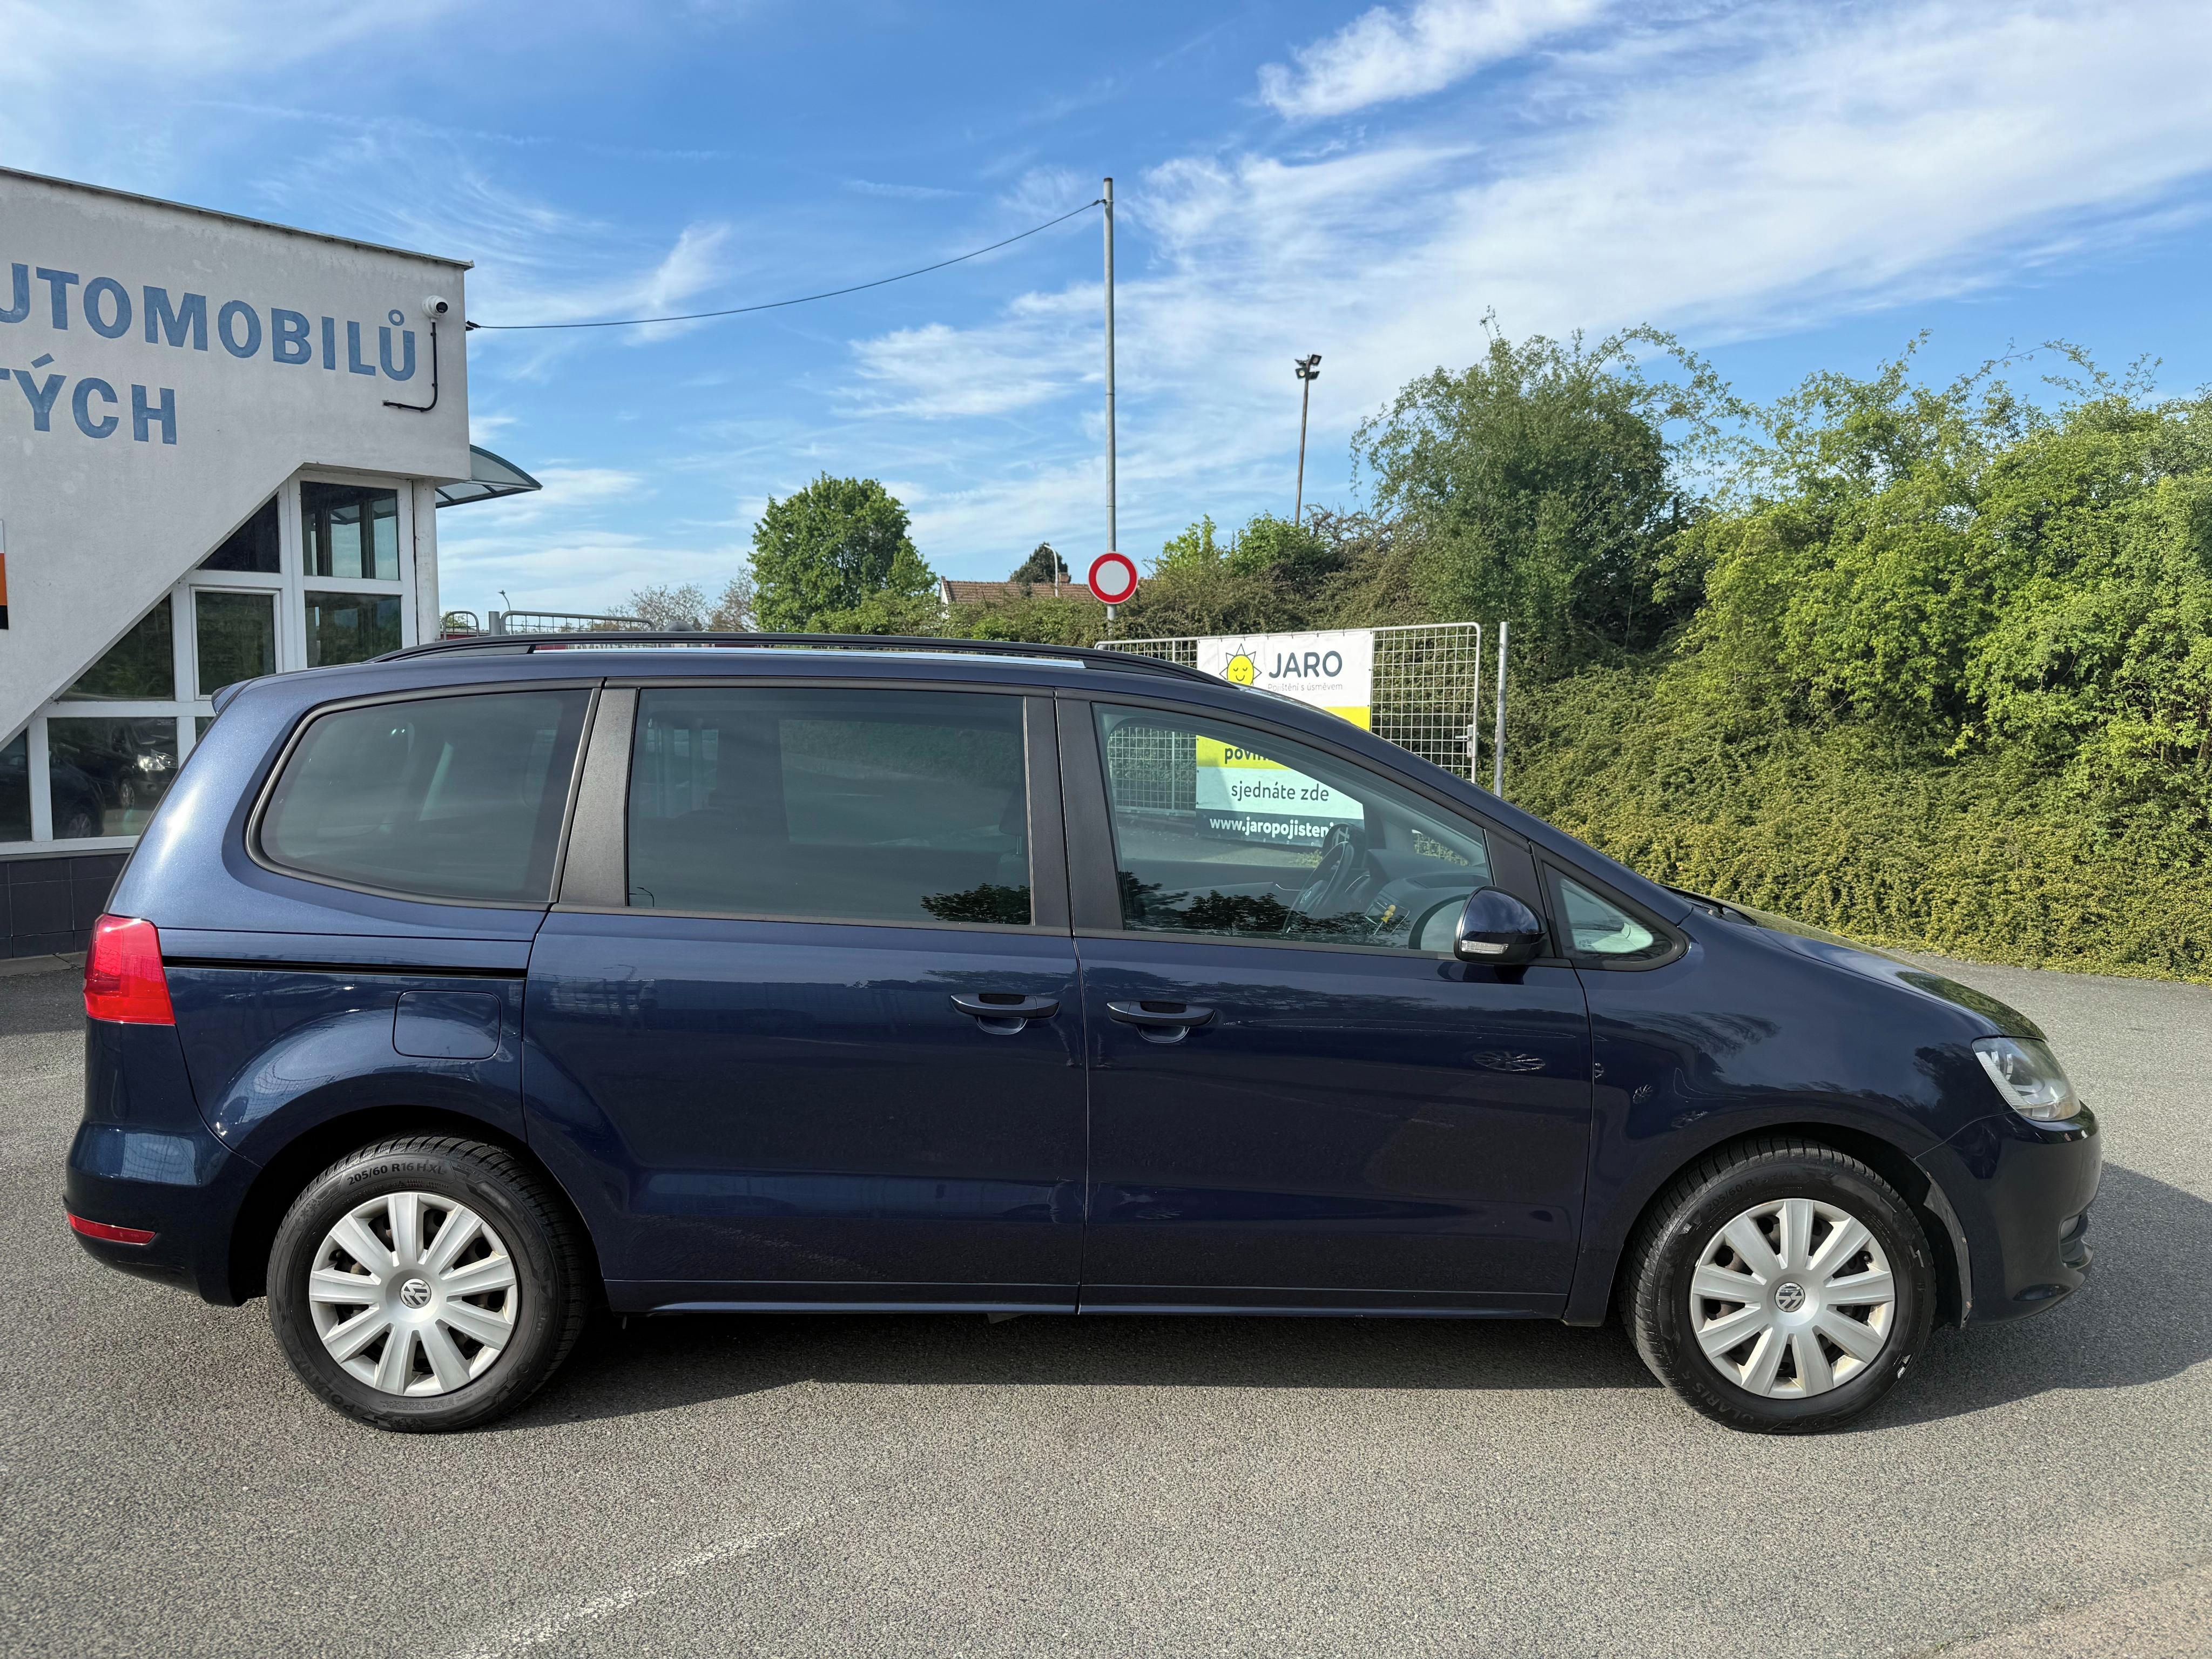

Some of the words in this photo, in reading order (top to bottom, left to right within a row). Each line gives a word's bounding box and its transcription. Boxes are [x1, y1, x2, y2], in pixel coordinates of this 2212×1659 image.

[1269, 650, 1343, 678] JARO
[1268, 683, 1299, 692] Pojištění
[1307, 682, 1343, 691] úsměvem
[1231, 781, 1296, 801] sjednáte
[1300, 784, 1329, 801] zde
[347, 1165, 388, 1185] 205/60
[392, 1163, 414, 1172] R16
